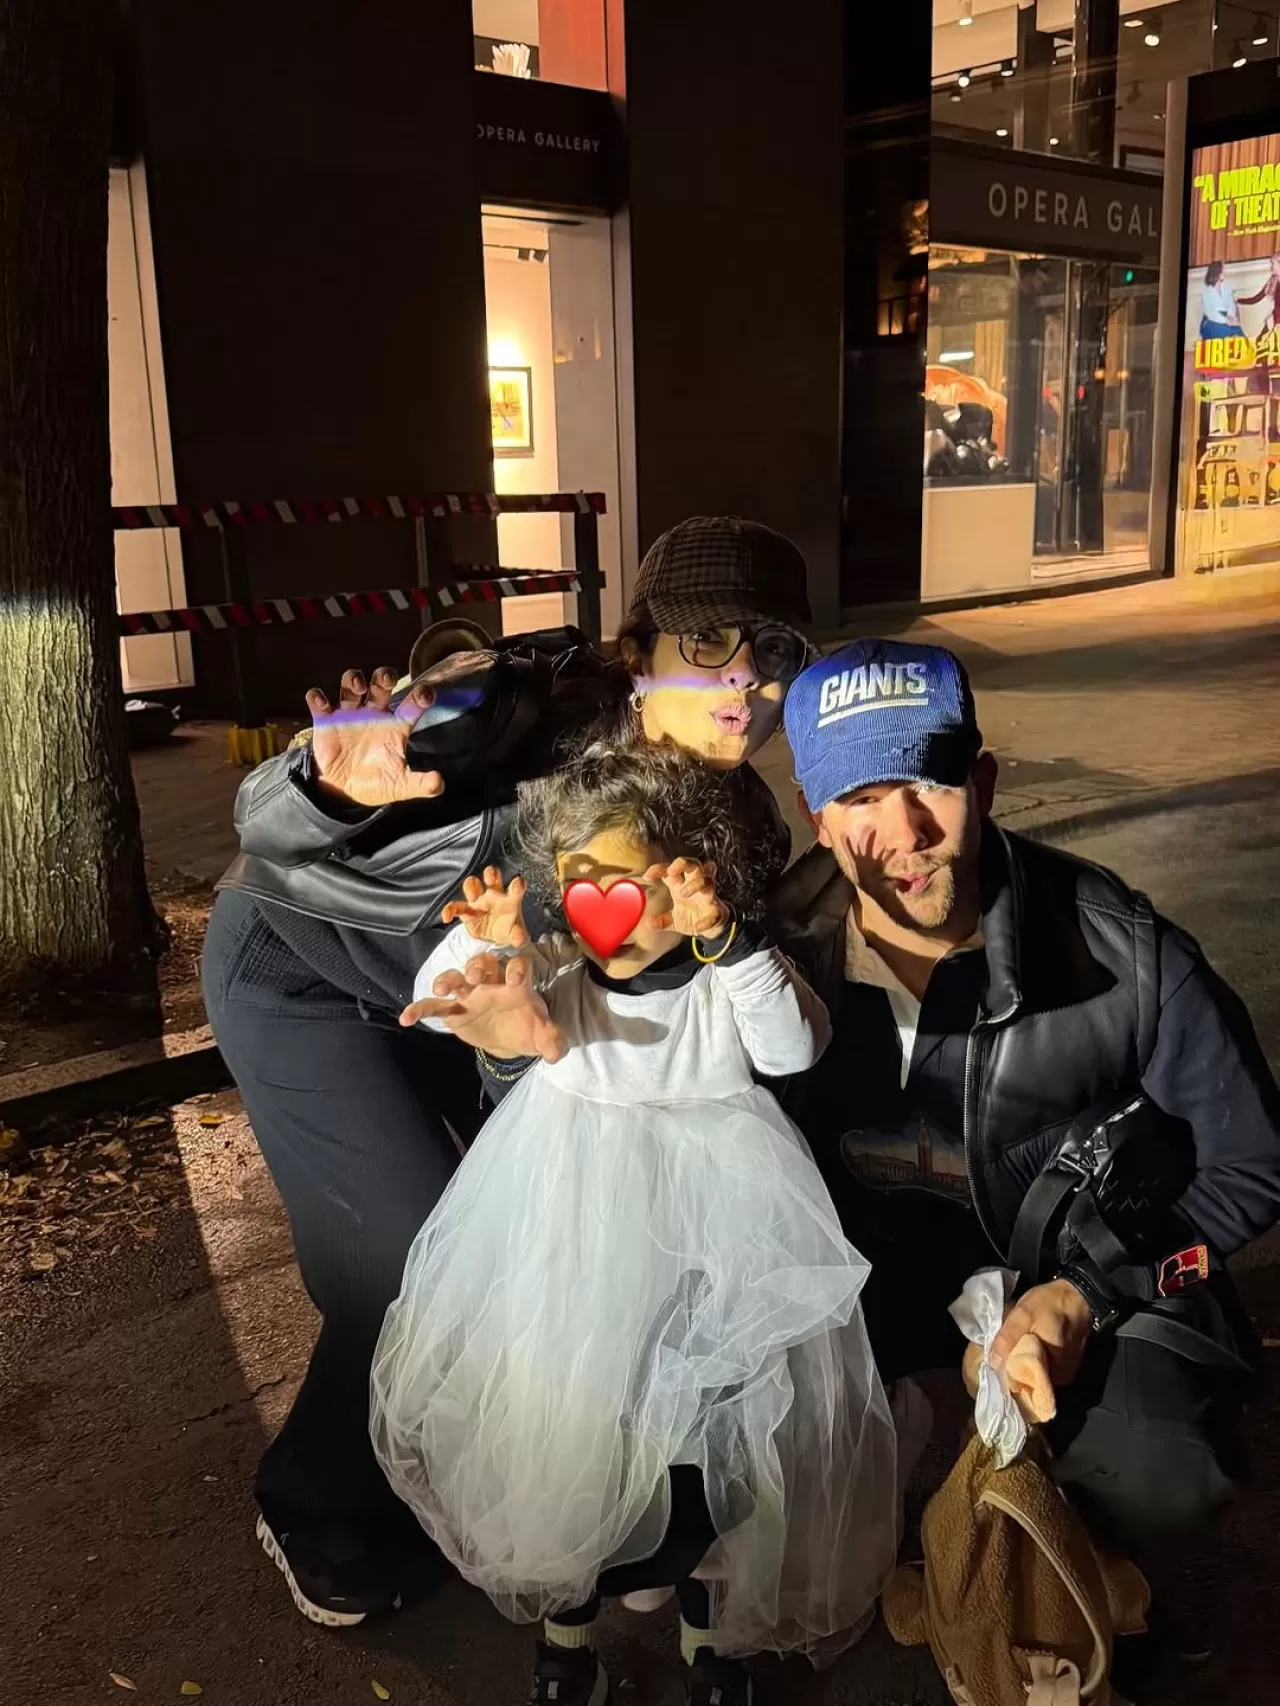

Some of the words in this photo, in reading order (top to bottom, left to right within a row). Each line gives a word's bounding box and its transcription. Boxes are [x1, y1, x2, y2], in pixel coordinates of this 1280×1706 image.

[534, 131, 600, 153] GALLERY
[988, 182, 1089, 229] OPERA
[1106, 200, 1158, 238] GAL
[1210, 199, 1230, 231] OF
[818, 662, 929, 715] GIANTS
